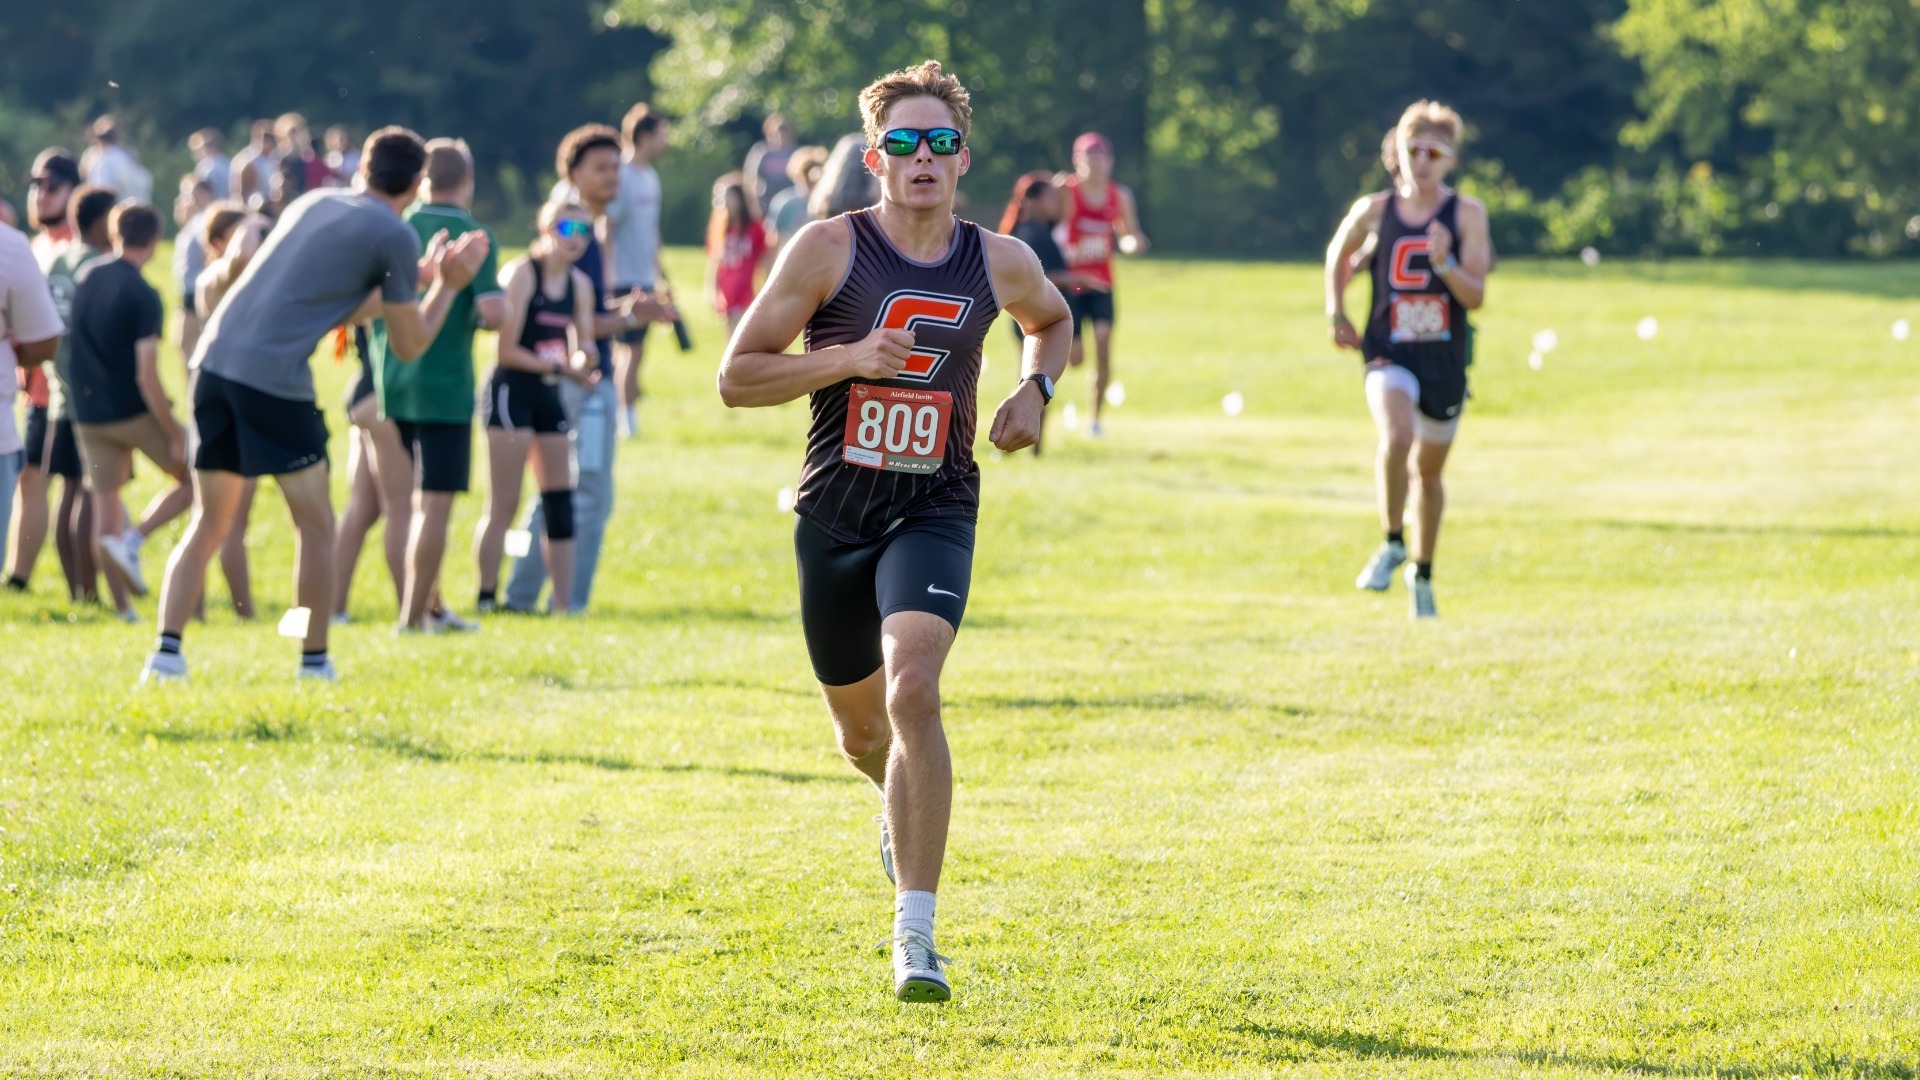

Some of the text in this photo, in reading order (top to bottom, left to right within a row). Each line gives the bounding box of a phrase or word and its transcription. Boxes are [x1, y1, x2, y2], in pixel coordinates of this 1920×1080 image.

[1389, 236, 1431, 290] C
[890, 391, 933, 401] Airfield Invite
[857, 400, 939, 455] 809
